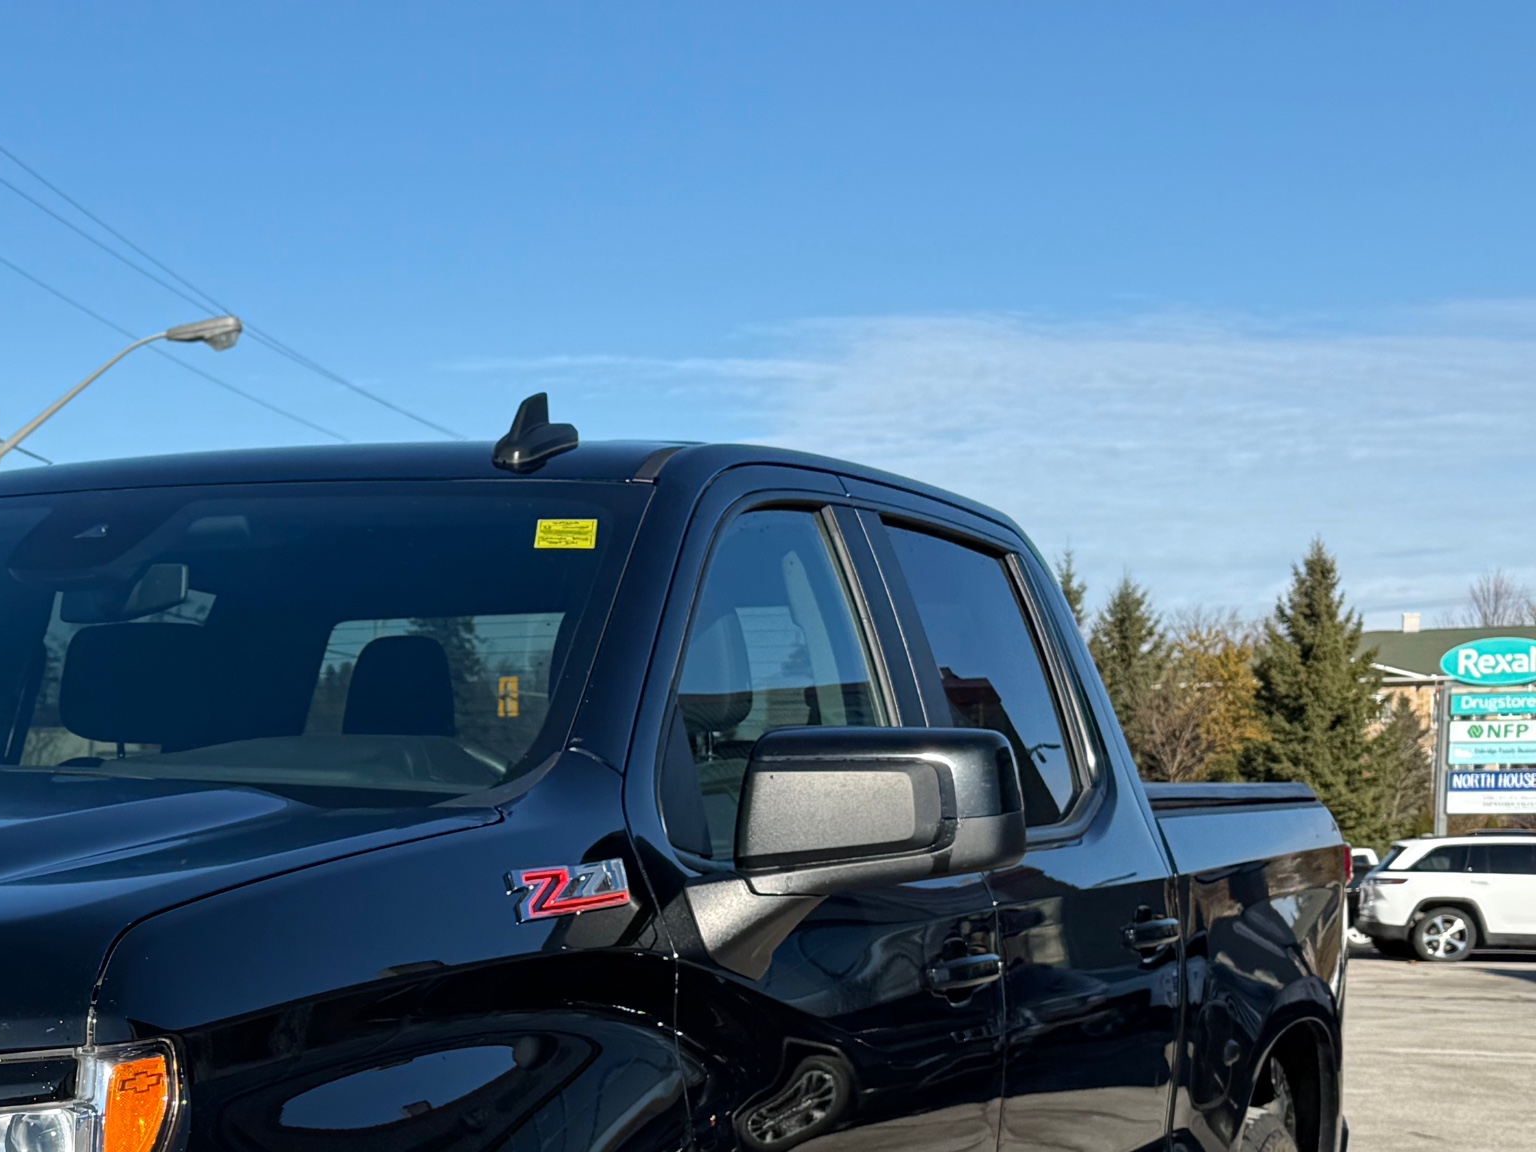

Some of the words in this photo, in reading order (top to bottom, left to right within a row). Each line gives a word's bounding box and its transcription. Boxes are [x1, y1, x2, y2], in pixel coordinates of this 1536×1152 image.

[1461, 695, 1536, 713] Drugstore
[1486, 724, 1530, 739] NFP
[1452, 773, 1496, 789] NORTH
[1498, 772, 1536, 788] HOUSE
